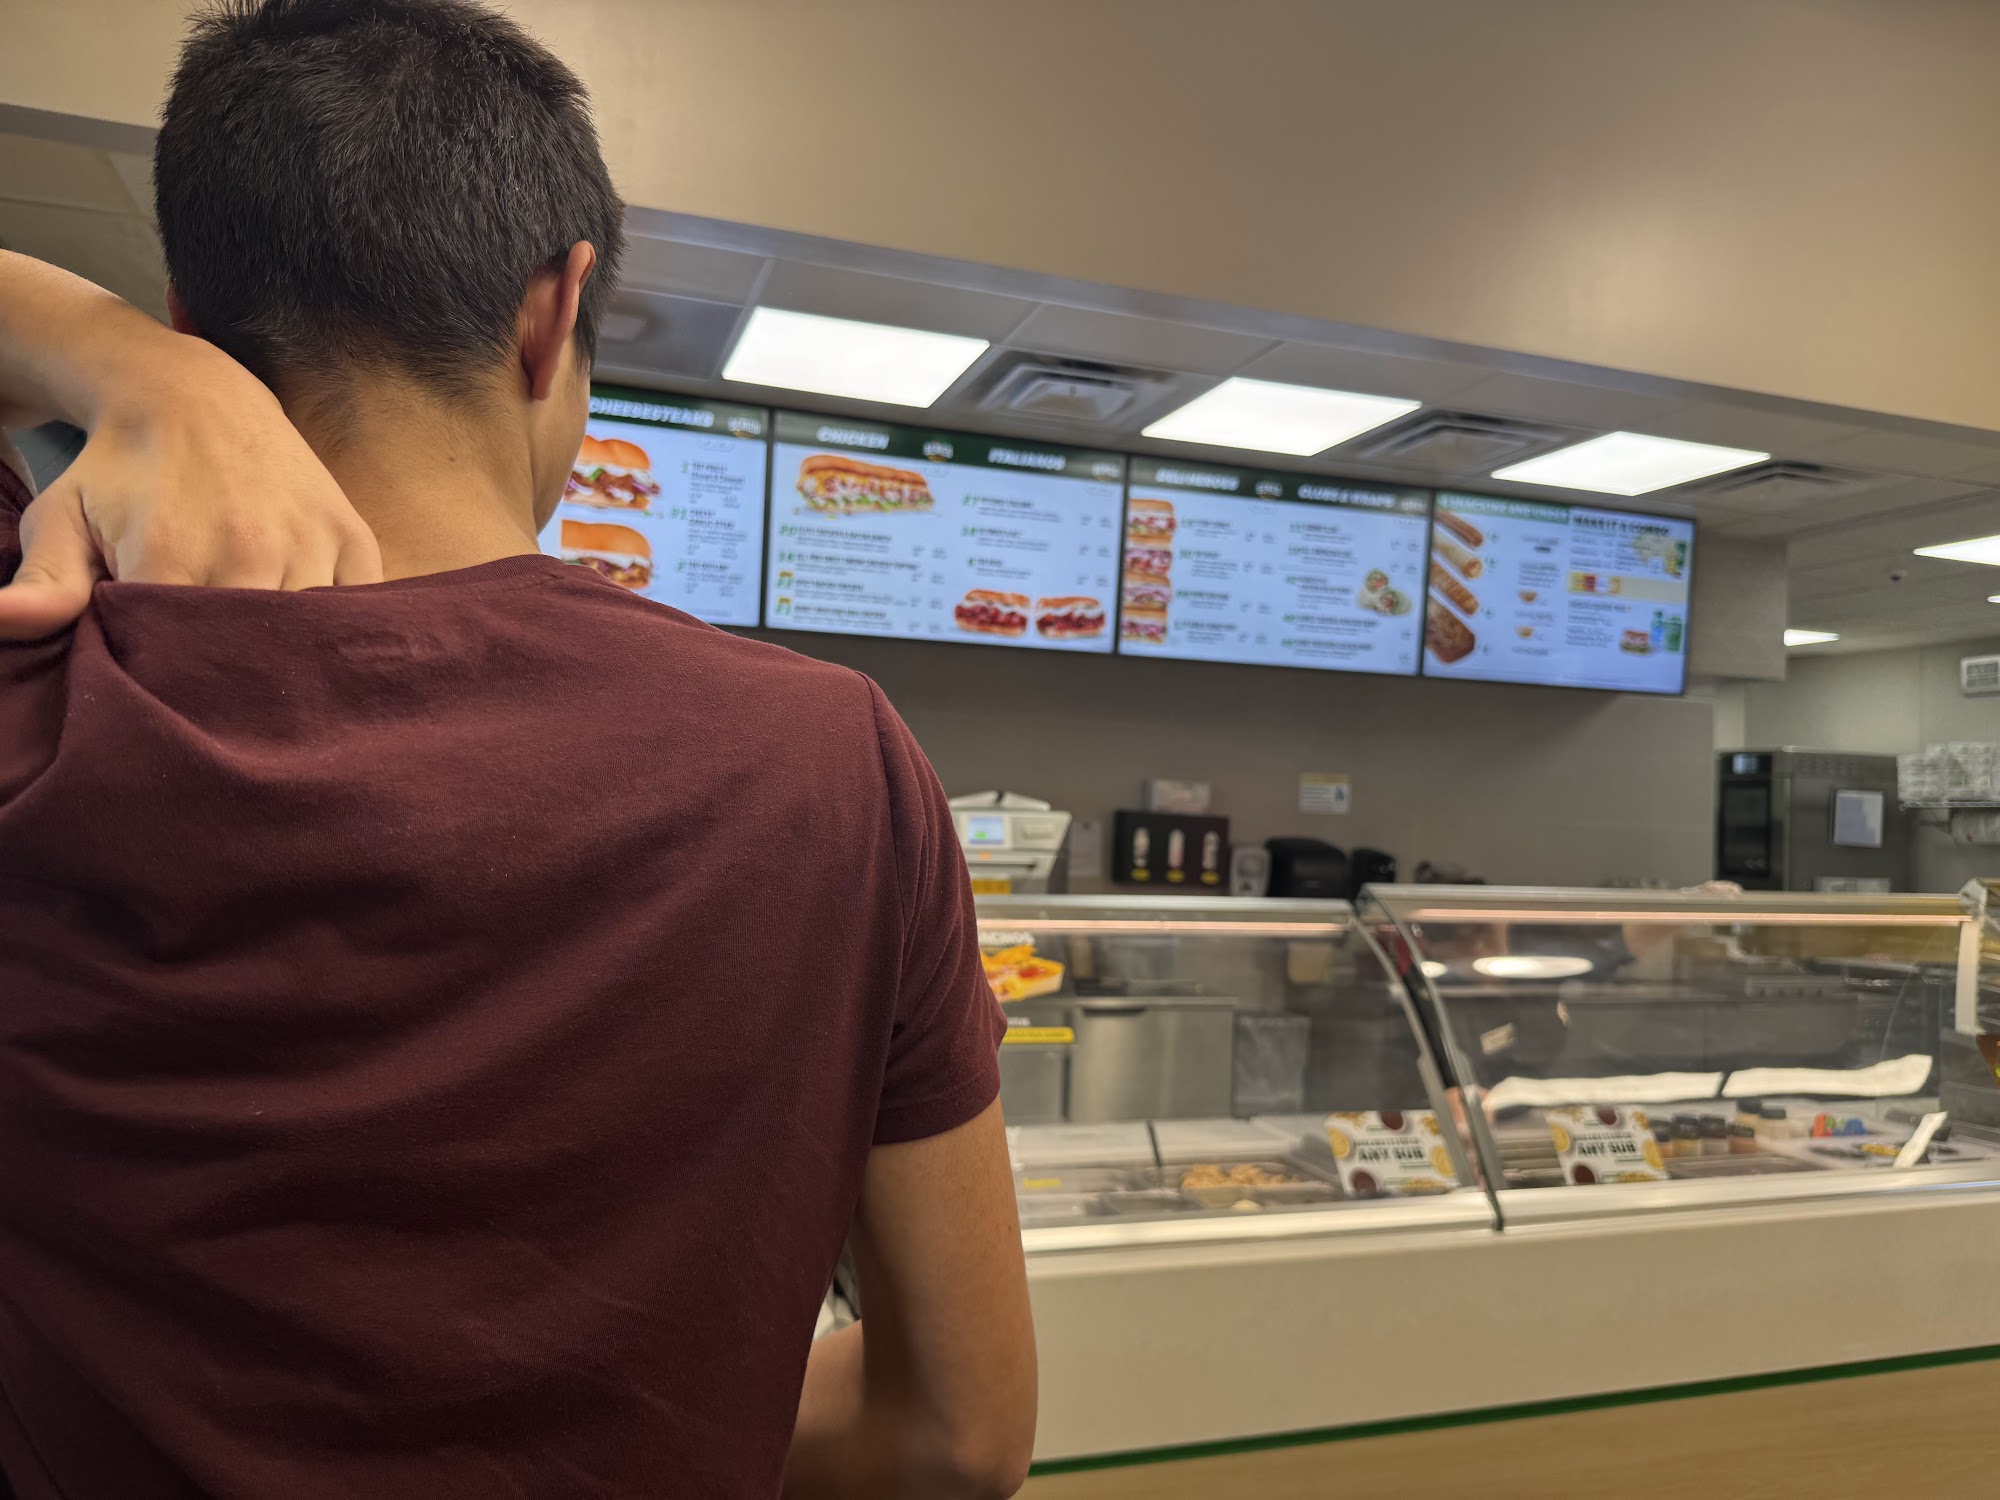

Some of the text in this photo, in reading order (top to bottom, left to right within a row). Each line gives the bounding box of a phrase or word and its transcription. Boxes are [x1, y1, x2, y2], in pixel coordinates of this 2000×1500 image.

[590, 397, 715, 428] CHEESESTEAKS
[816, 425, 890, 450] CHICKEN
[1359, 1146, 1425, 1161] ANY SUB
[1577, 1141, 1637, 1156] ANY SUB
